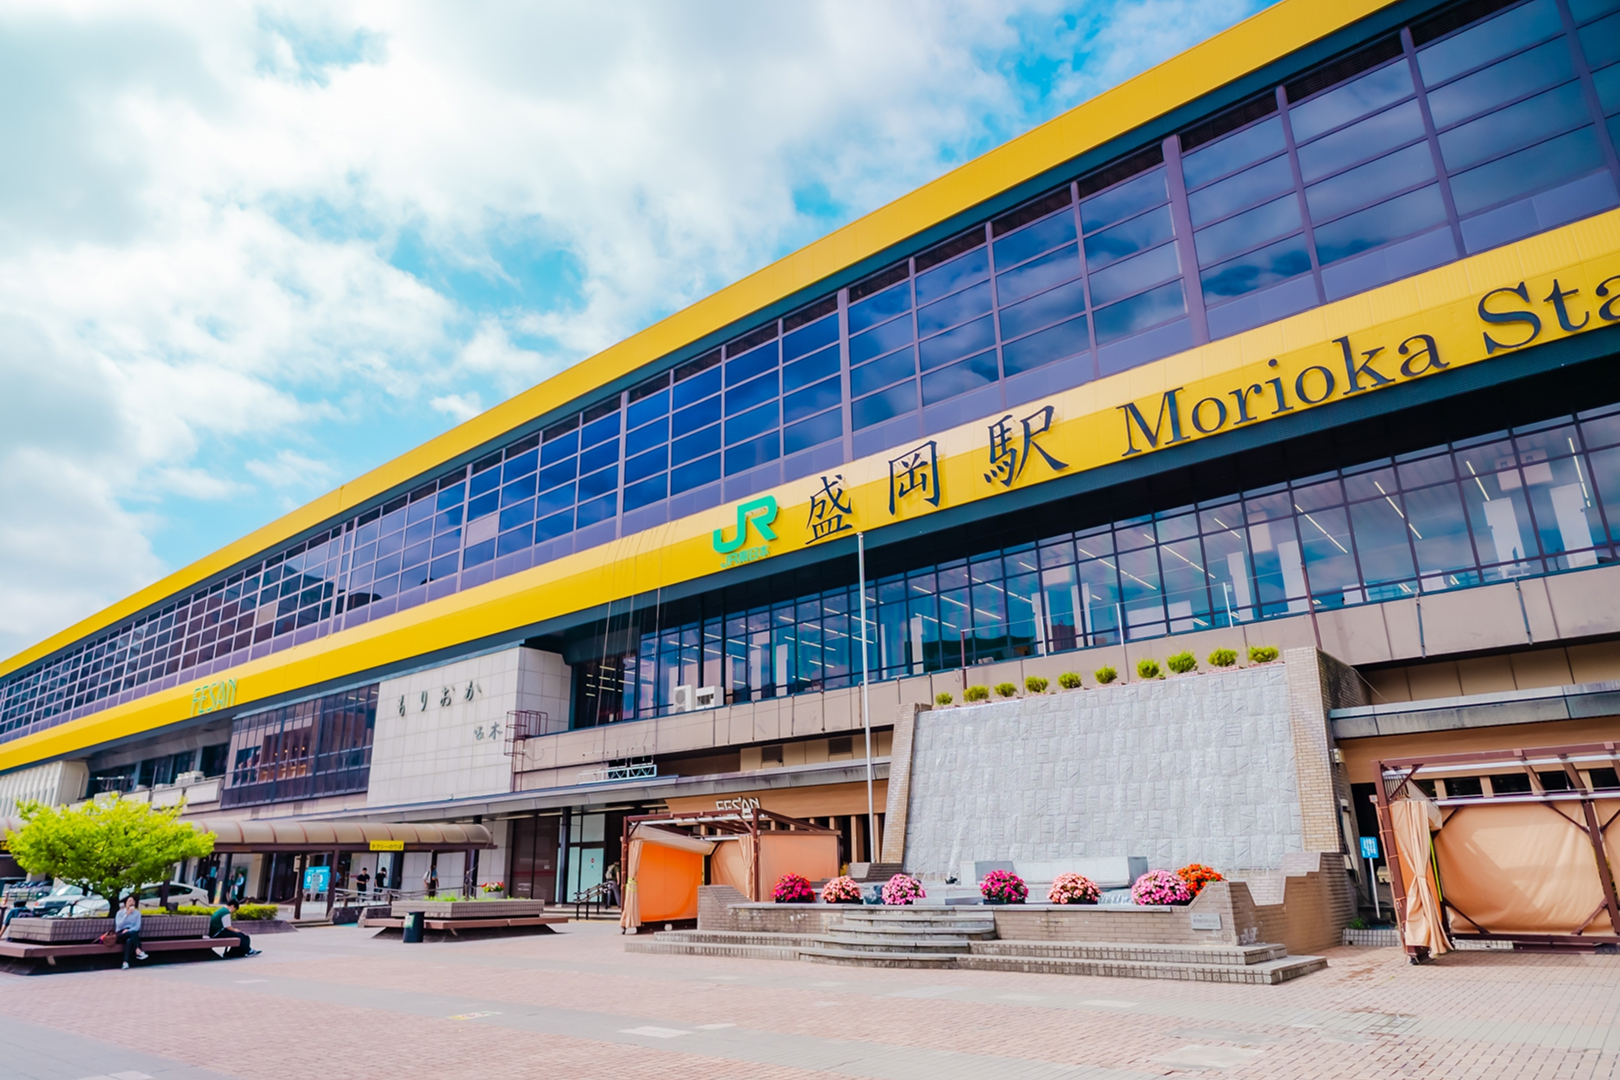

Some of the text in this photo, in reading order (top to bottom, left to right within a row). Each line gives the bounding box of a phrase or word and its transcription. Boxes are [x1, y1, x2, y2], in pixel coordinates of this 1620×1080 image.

[804, 405, 1069, 546] 盛岡駅
[1115, 331, 1449, 457] Morioka
[712, 494, 779, 554] JR
[720, 544, 771, 569] JR東日本
[190, 677, 237, 718] FESAN
[397, 680, 482, 717] もりおか
